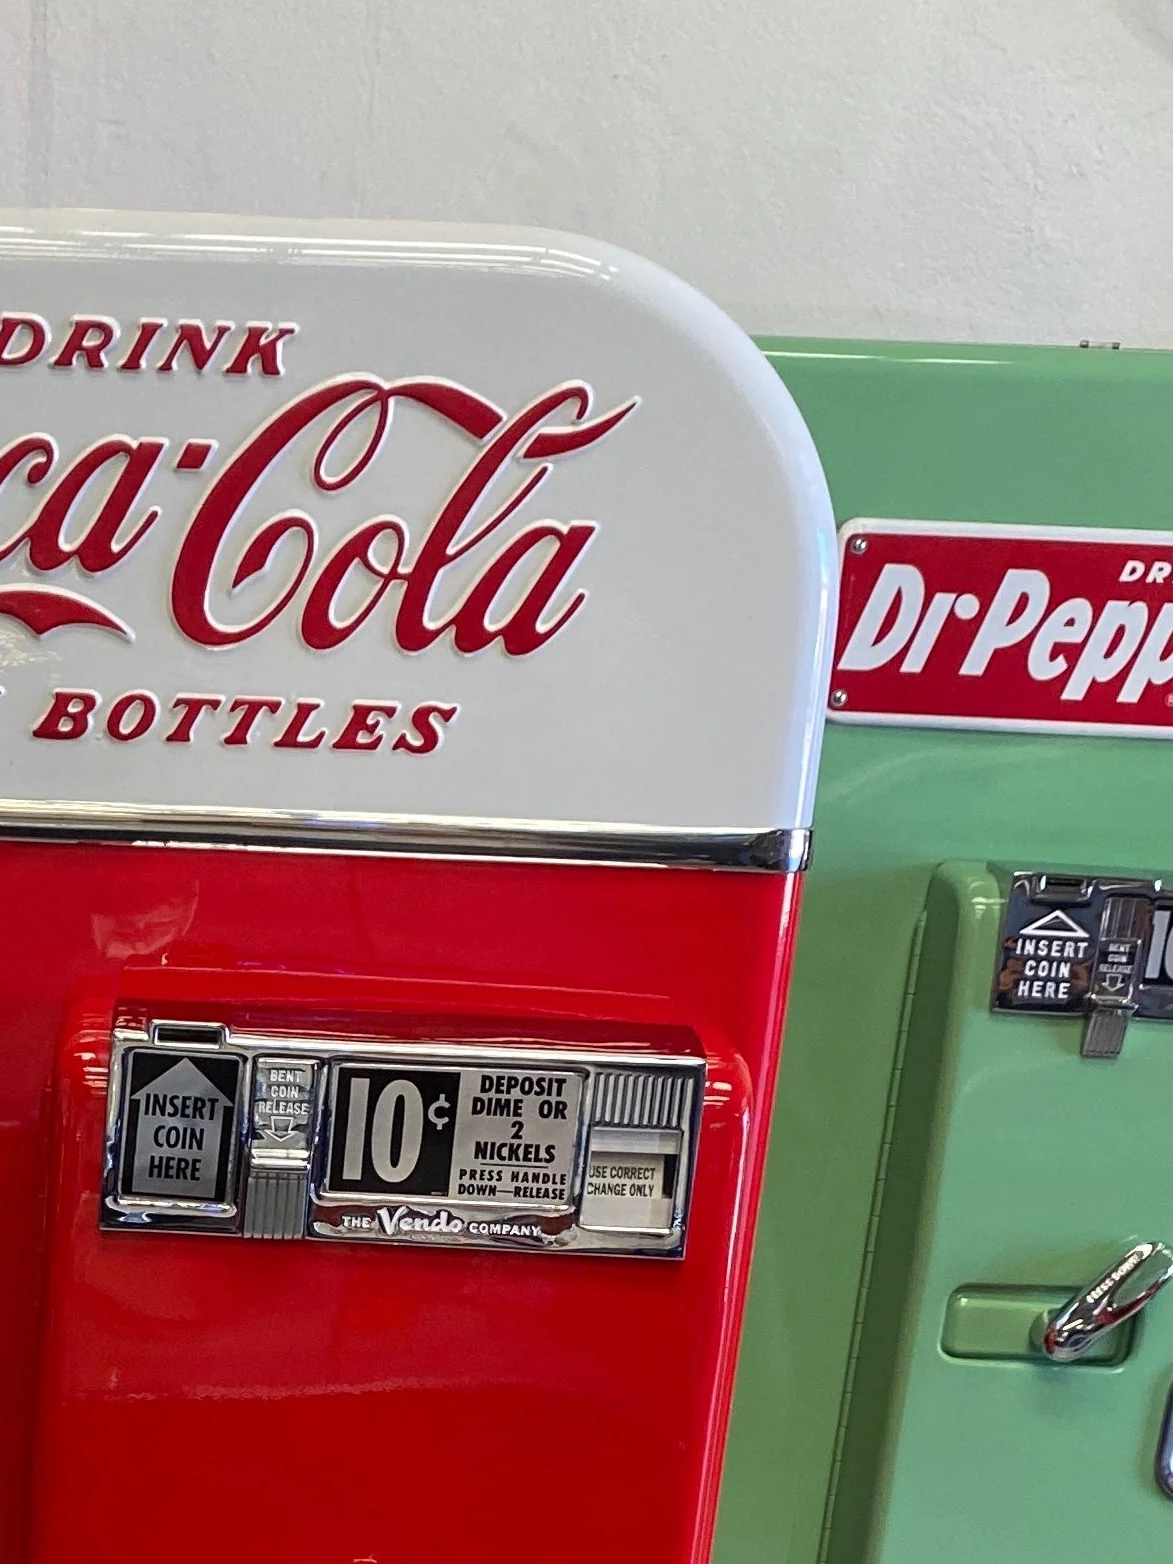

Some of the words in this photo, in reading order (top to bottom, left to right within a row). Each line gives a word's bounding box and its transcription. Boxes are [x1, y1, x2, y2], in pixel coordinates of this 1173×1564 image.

[31, 687, 462, 756] BOTTLES
[1015, 938, 1088, 959] INSERT
[1024, 960, 1070, 978] COIN
[1018, 979, 1069, 999] HERE
[270, 1070, 303, 1082] BENT
[480, 1074, 567, 1097] DEPOSIT
[271, 1085, 299, 1098] COIN
[144, 1093, 219, 1120] INSERT
[258, 1100, 310, 1115] RELEASE
[471, 1096, 524, 1118] DIME
[538, 1099, 568, 1120] OR
[153, 1125, 204, 1150] COIN
[510, 1120, 524, 1140] 2
[474, 1141, 556, 1163] NICKELS
[148, 1155, 201, 1180] HERE
[459, 1168, 503, 1182] PRESS
[510, 1171, 567, 1185] HANDLE
[589, 1165, 607, 1179] USE
[610, 1166, 656, 1180] CORRECT
[587, 1182, 627, 1196] CHANGE
[629, 1184, 655, 1198] ONLY
[342, 1215, 372, 1230] THE
[377, 1205, 466, 1236] Vendo
[469, 1222, 542, 1237] COMPANY
